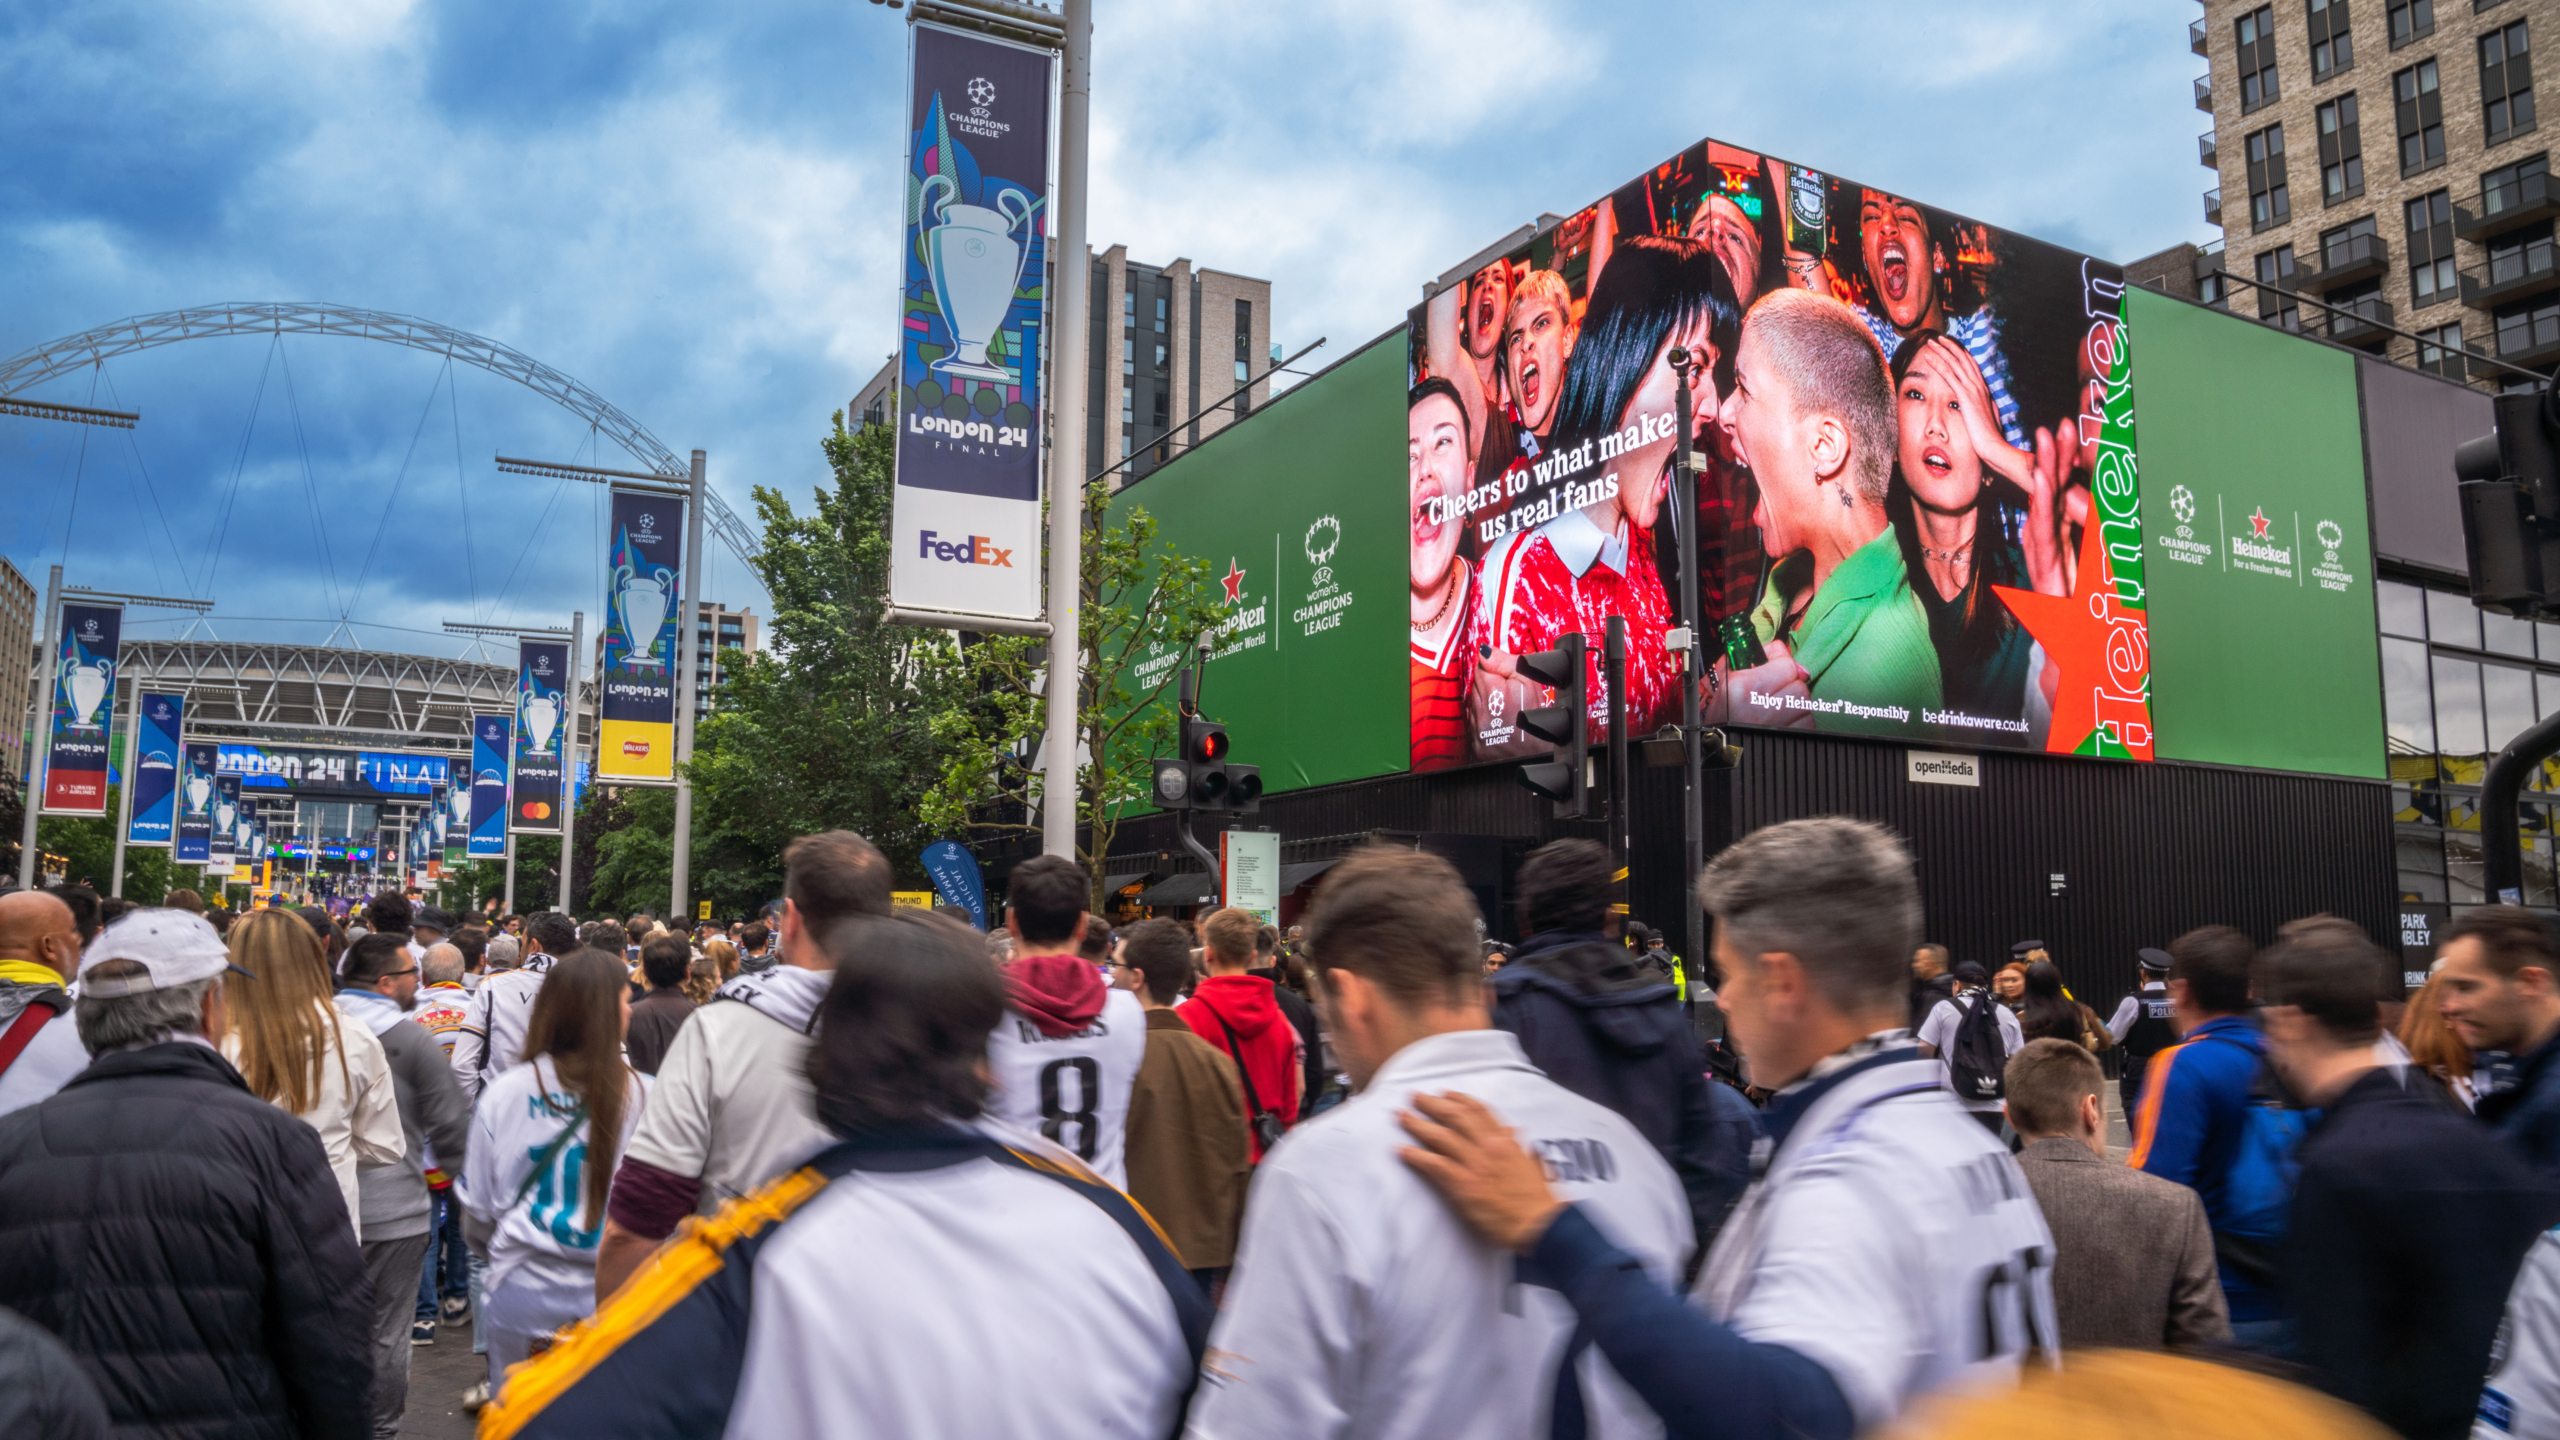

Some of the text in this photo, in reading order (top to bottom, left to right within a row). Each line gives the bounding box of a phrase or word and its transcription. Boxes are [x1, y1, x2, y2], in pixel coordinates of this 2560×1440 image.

[949, 112, 1010, 132] CHAMPIONS
[970, 108, 990, 119] UEFA
[960, 124, 999, 138] LEAGUE
[998, 426, 1027, 447] 24
[935, 441, 1000, 457] FINAL
[1429, 480, 1501, 526] Cheers
[1505, 469, 1528, 495] to
[1532, 438, 1593, 486] what
[1480, 472, 1620, 542] us real fans
[920, 529, 1013, 568] FedEx
[2159, 536, 2212, 555] CHAMPIONS
[2169, 549, 2204, 565] LEAGUE
[2234, 558, 2244, 568] For
[2250, 562, 2273, 574] Fresher
[2274, 566, 2292, 578] World
[2312, 567, 2353, 583] CHAMPIONS
[1312, 569, 1331, 586] UEFA
[2321, 579, 2346, 592] LEAGUE
[1306, 581, 1339, 602] women's
[1293, 591, 1352, 623] CHAMPIONS
[1304, 612, 1341, 636] LEAGUE
[1245, 631, 1266, 649] World
[1134, 651, 1180, 677] CHAMPIONS
[653, 687, 668, 697] 24
[1750, 691, 1783, 710] Enjoy
[1844, 701, 1910, 723] Responsibly
[1480, 726, 1515, 739] CHAMPIONS
[1486, 736, 1508, 746] LEAGUE
[92, 745, 105, 753] 24
[624, 743, 650, 752] WALKERS
[308, 758, 346, 781] 24
[356, 761, 447, 784] FINAL
[2151, 1007, 2177, 1016] POLIC
[1039, 1056, 1099, 1162] 8
